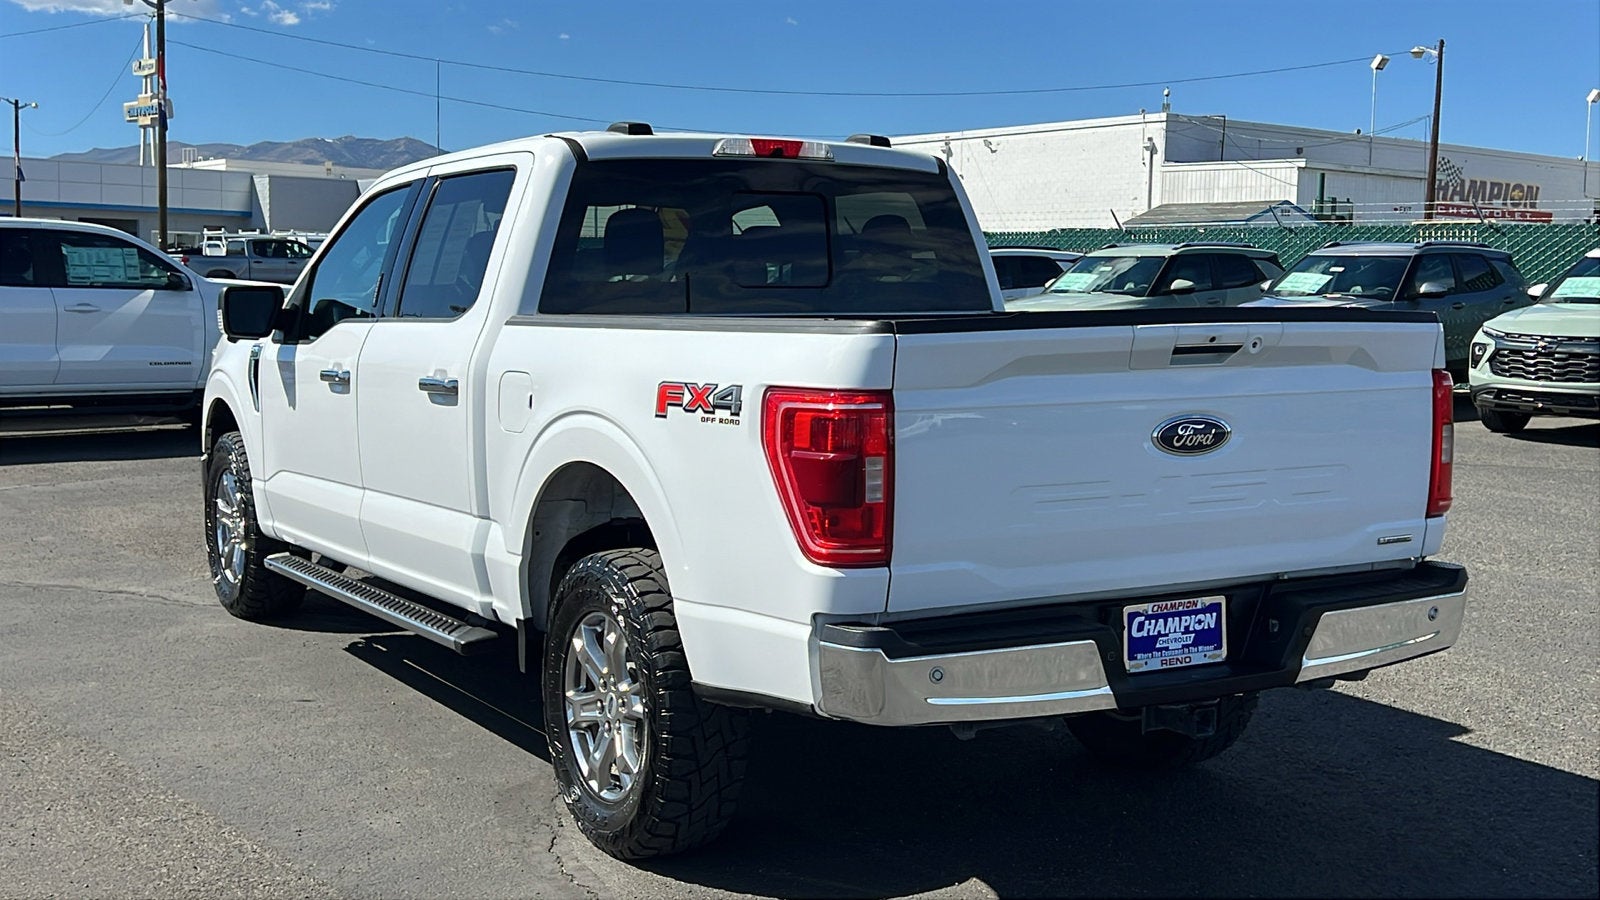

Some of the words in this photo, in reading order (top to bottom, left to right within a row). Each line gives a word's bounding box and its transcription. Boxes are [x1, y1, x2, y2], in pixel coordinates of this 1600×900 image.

[1436, 179, 1540, 209] HAMPION
[655, 381, 743, 419] FX4
[719, 417, 740, 426] ROAD
[1173, 423, 1216, 447] Ford
[1151, 600, 1199, 613] CHAMPION
[1158, 635, 1193, 645] CHEVROLET
[1160, 656, 1192, 668] RENO
